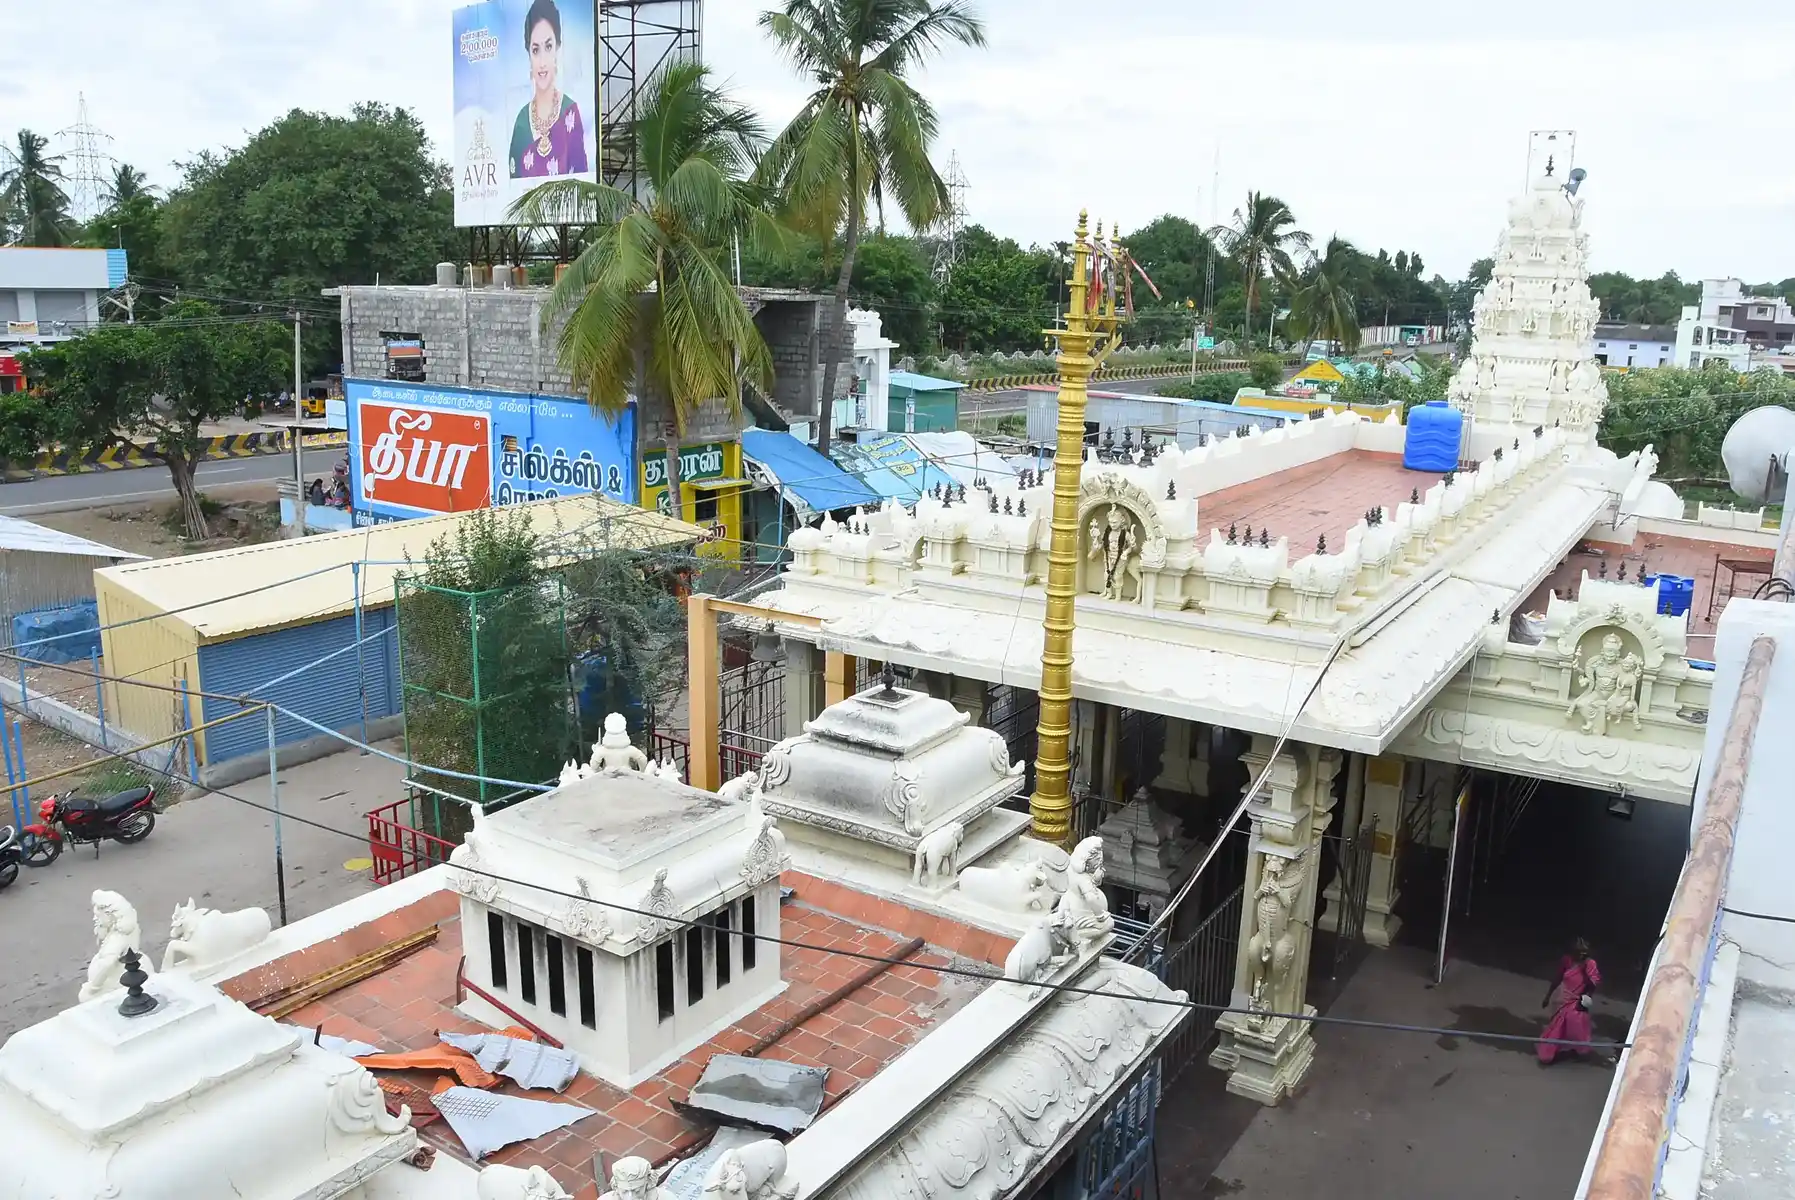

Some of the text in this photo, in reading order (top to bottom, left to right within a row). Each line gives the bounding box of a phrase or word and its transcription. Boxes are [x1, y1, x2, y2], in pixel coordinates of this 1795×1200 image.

[462, 163, 497, 188] AVR
[364, 409, 479, 492] தீபா
[501, 445, 623, 494] சில்க்ஸ் &
